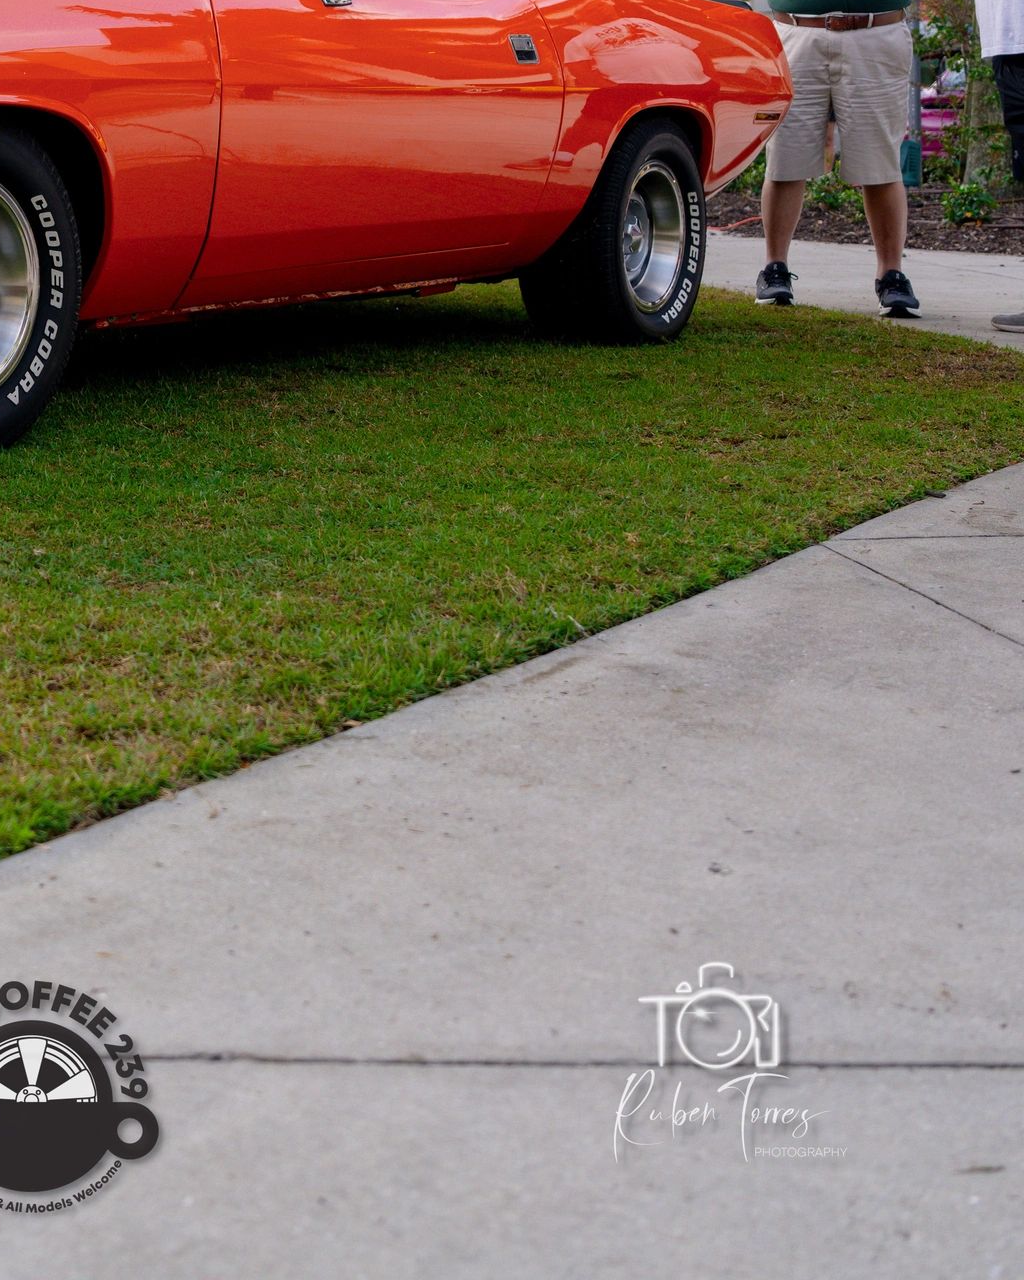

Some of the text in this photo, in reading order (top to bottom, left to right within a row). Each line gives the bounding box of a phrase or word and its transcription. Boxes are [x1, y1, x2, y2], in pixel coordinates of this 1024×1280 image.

[6, 194, 64, 406] COOPER COBRA
[661, 191, 701, 324] COOPER COBRA
